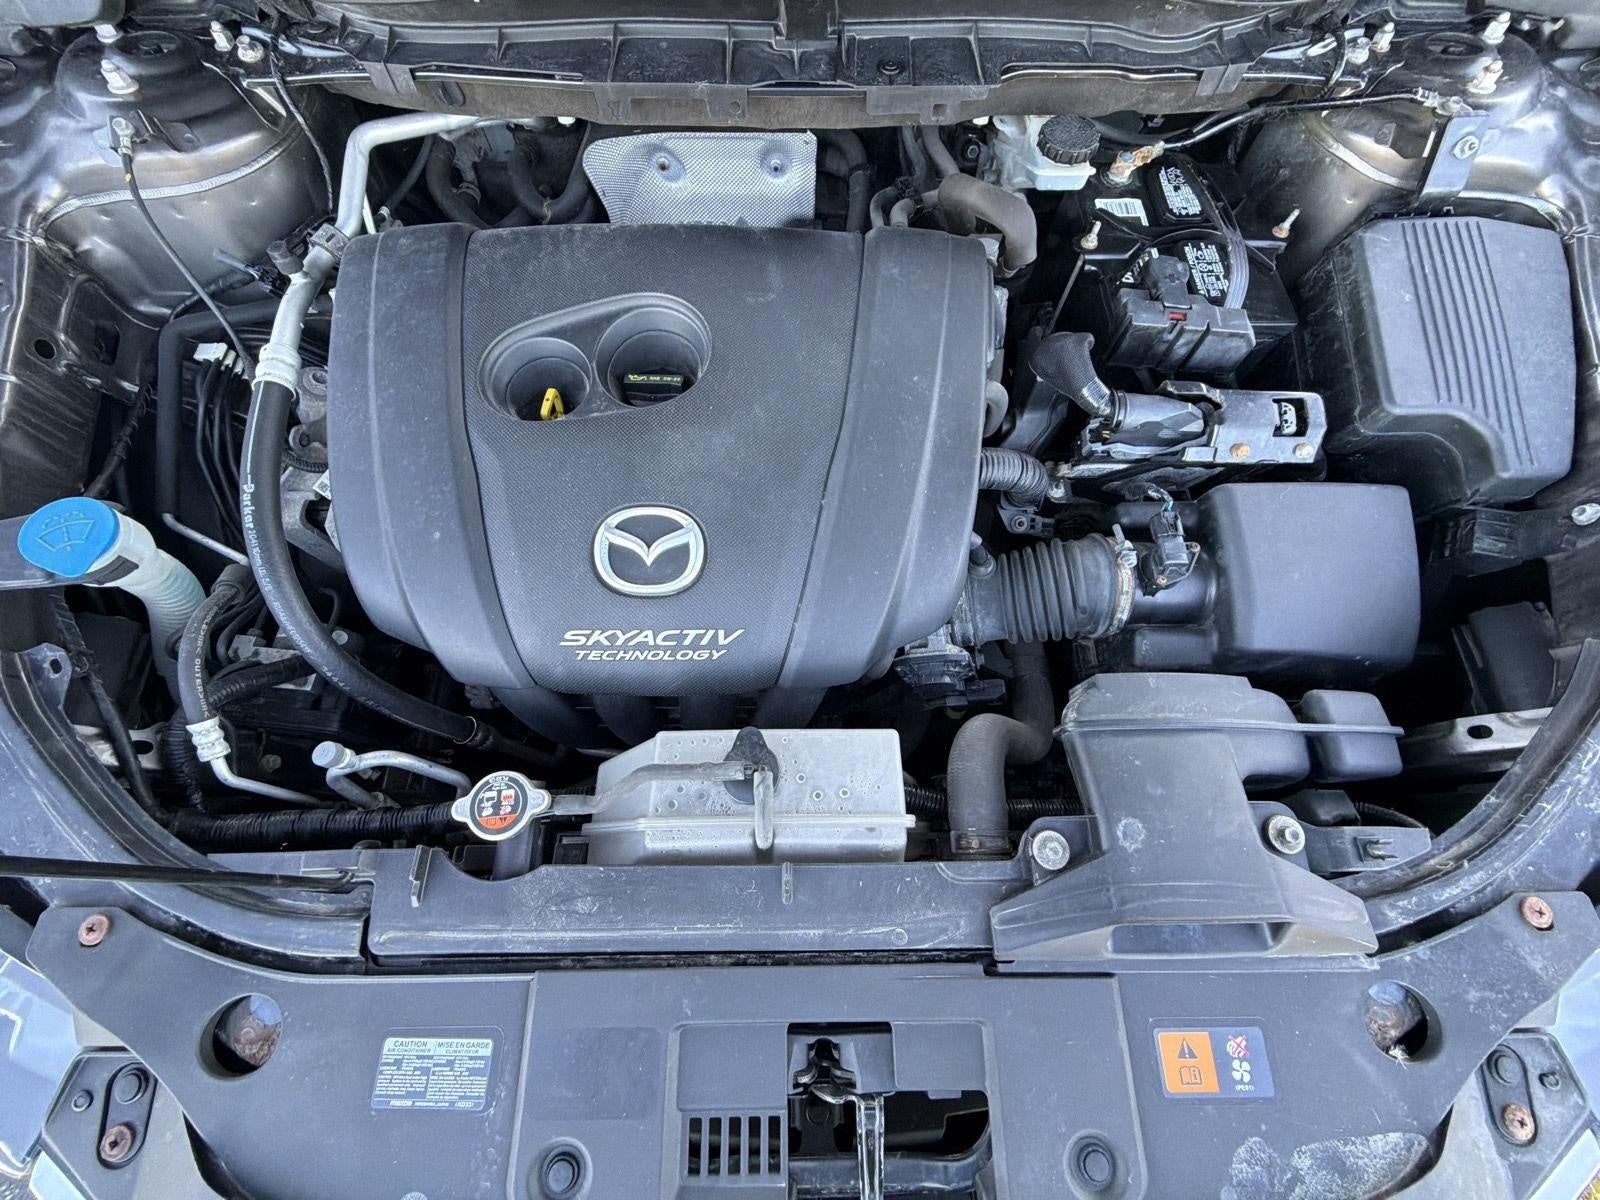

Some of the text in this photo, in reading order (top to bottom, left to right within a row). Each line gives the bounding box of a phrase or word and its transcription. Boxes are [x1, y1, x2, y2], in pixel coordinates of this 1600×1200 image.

[243, 484, 255, 528] Parker
[559, 629, 746, 646] SKYACTIV
[575, 650, 729, 661] TECHNOLOGY
